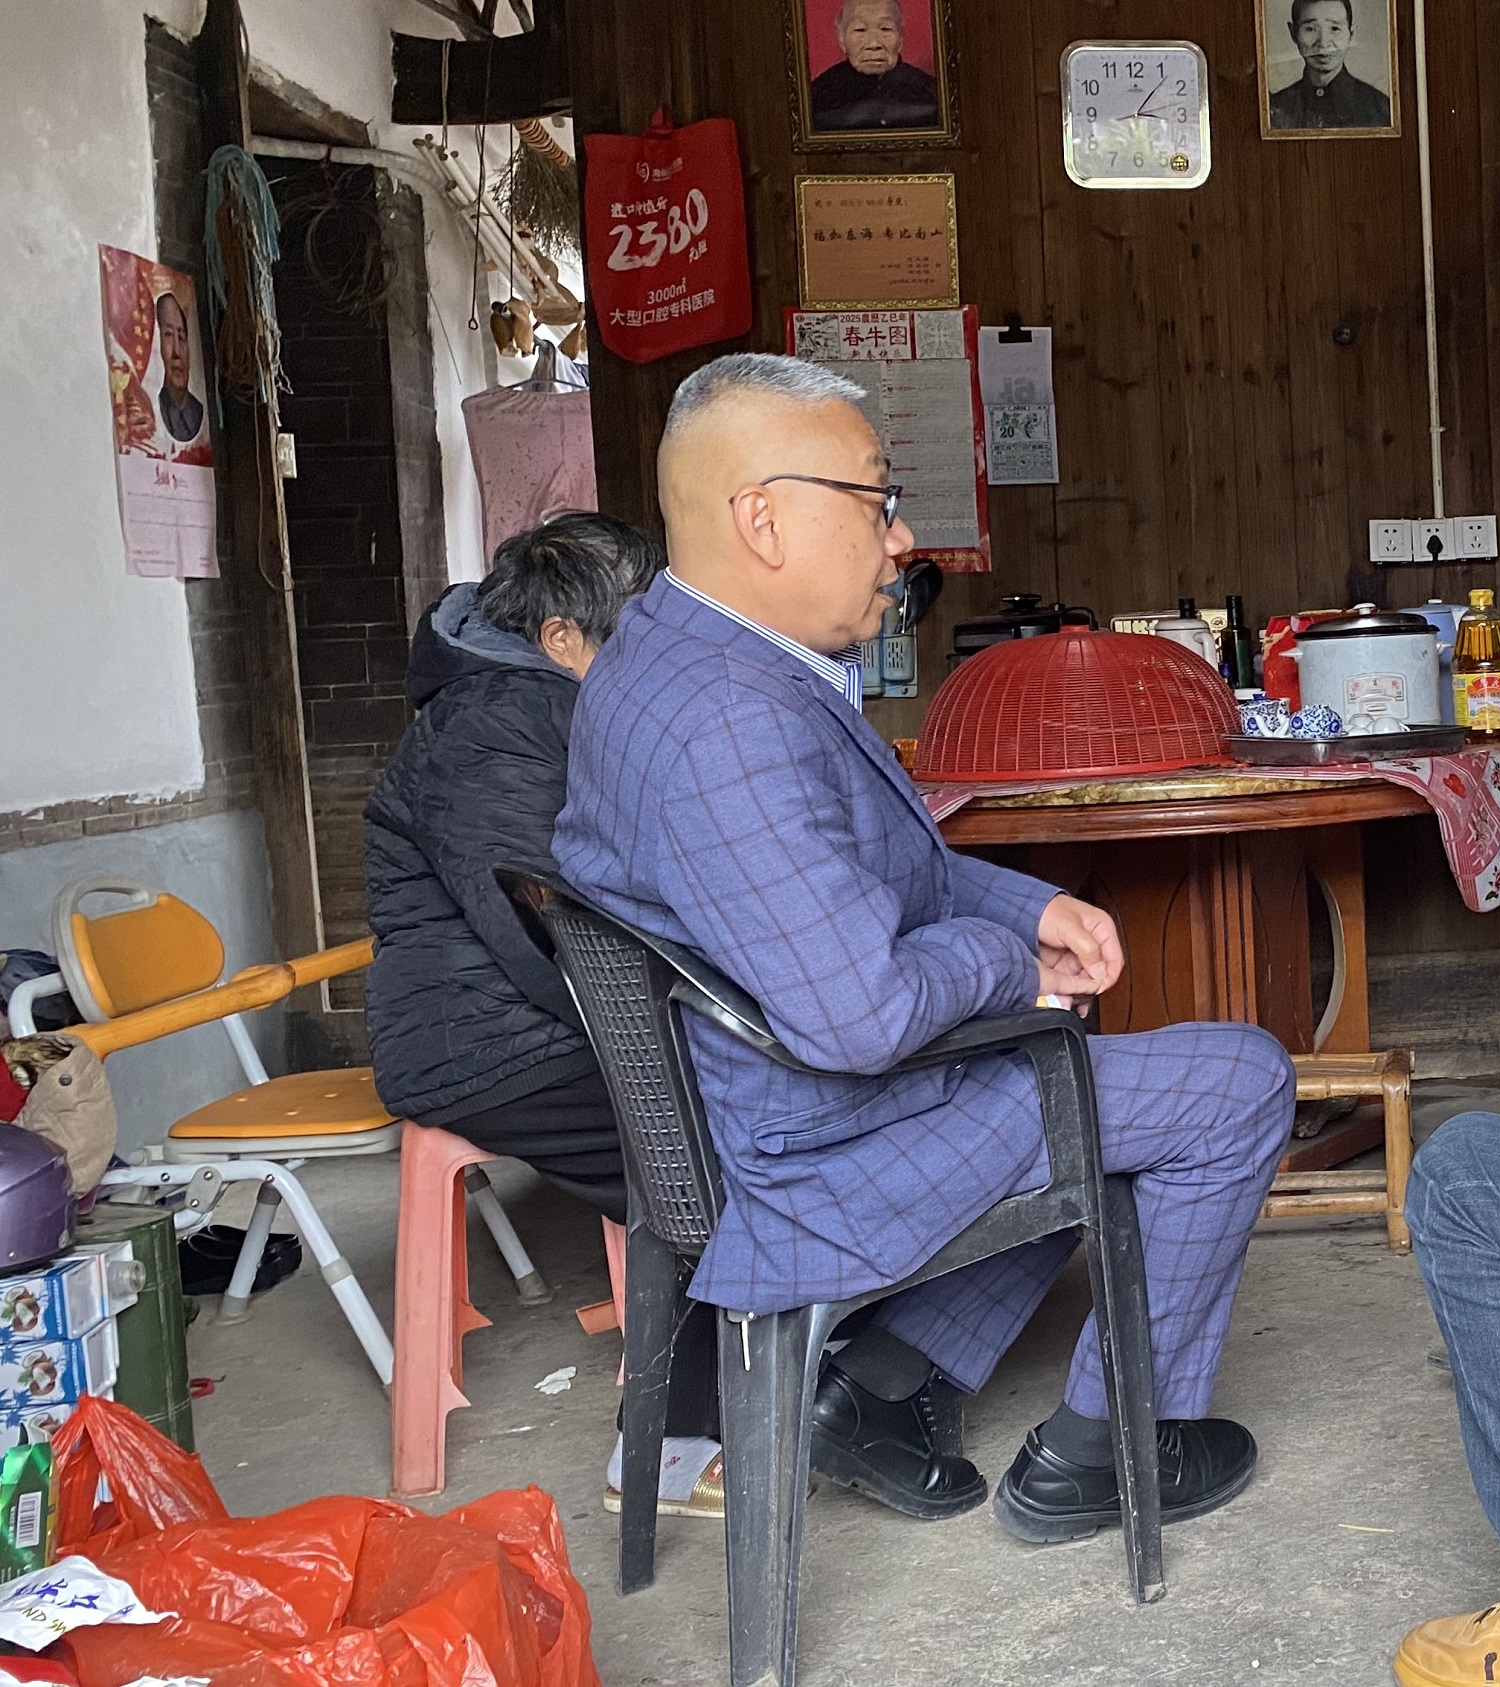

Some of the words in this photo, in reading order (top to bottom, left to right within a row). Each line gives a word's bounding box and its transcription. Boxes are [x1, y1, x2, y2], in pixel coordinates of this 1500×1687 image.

[1101, 62, 1117, 78] 11
[1125, 62, 1144, 78] 12
[1156, 62, 1164, 78] 1
[1081, 79, 1100, 96] 10
[1175, 80, 1187, 96] 2
[1086, 107, 1097, 123] 9
[1177, 108, 1187, 123] 3
[1108, 151, 1119, 167] 7
[1133, 151, 1144, 167] 6
[607, 188, 709, 271] 2380
[609, 288, 716, 327] 大型口腔专科医院
[843, 326, 908, 348] 春牛图
[999, 426, 1015, 438] 20
